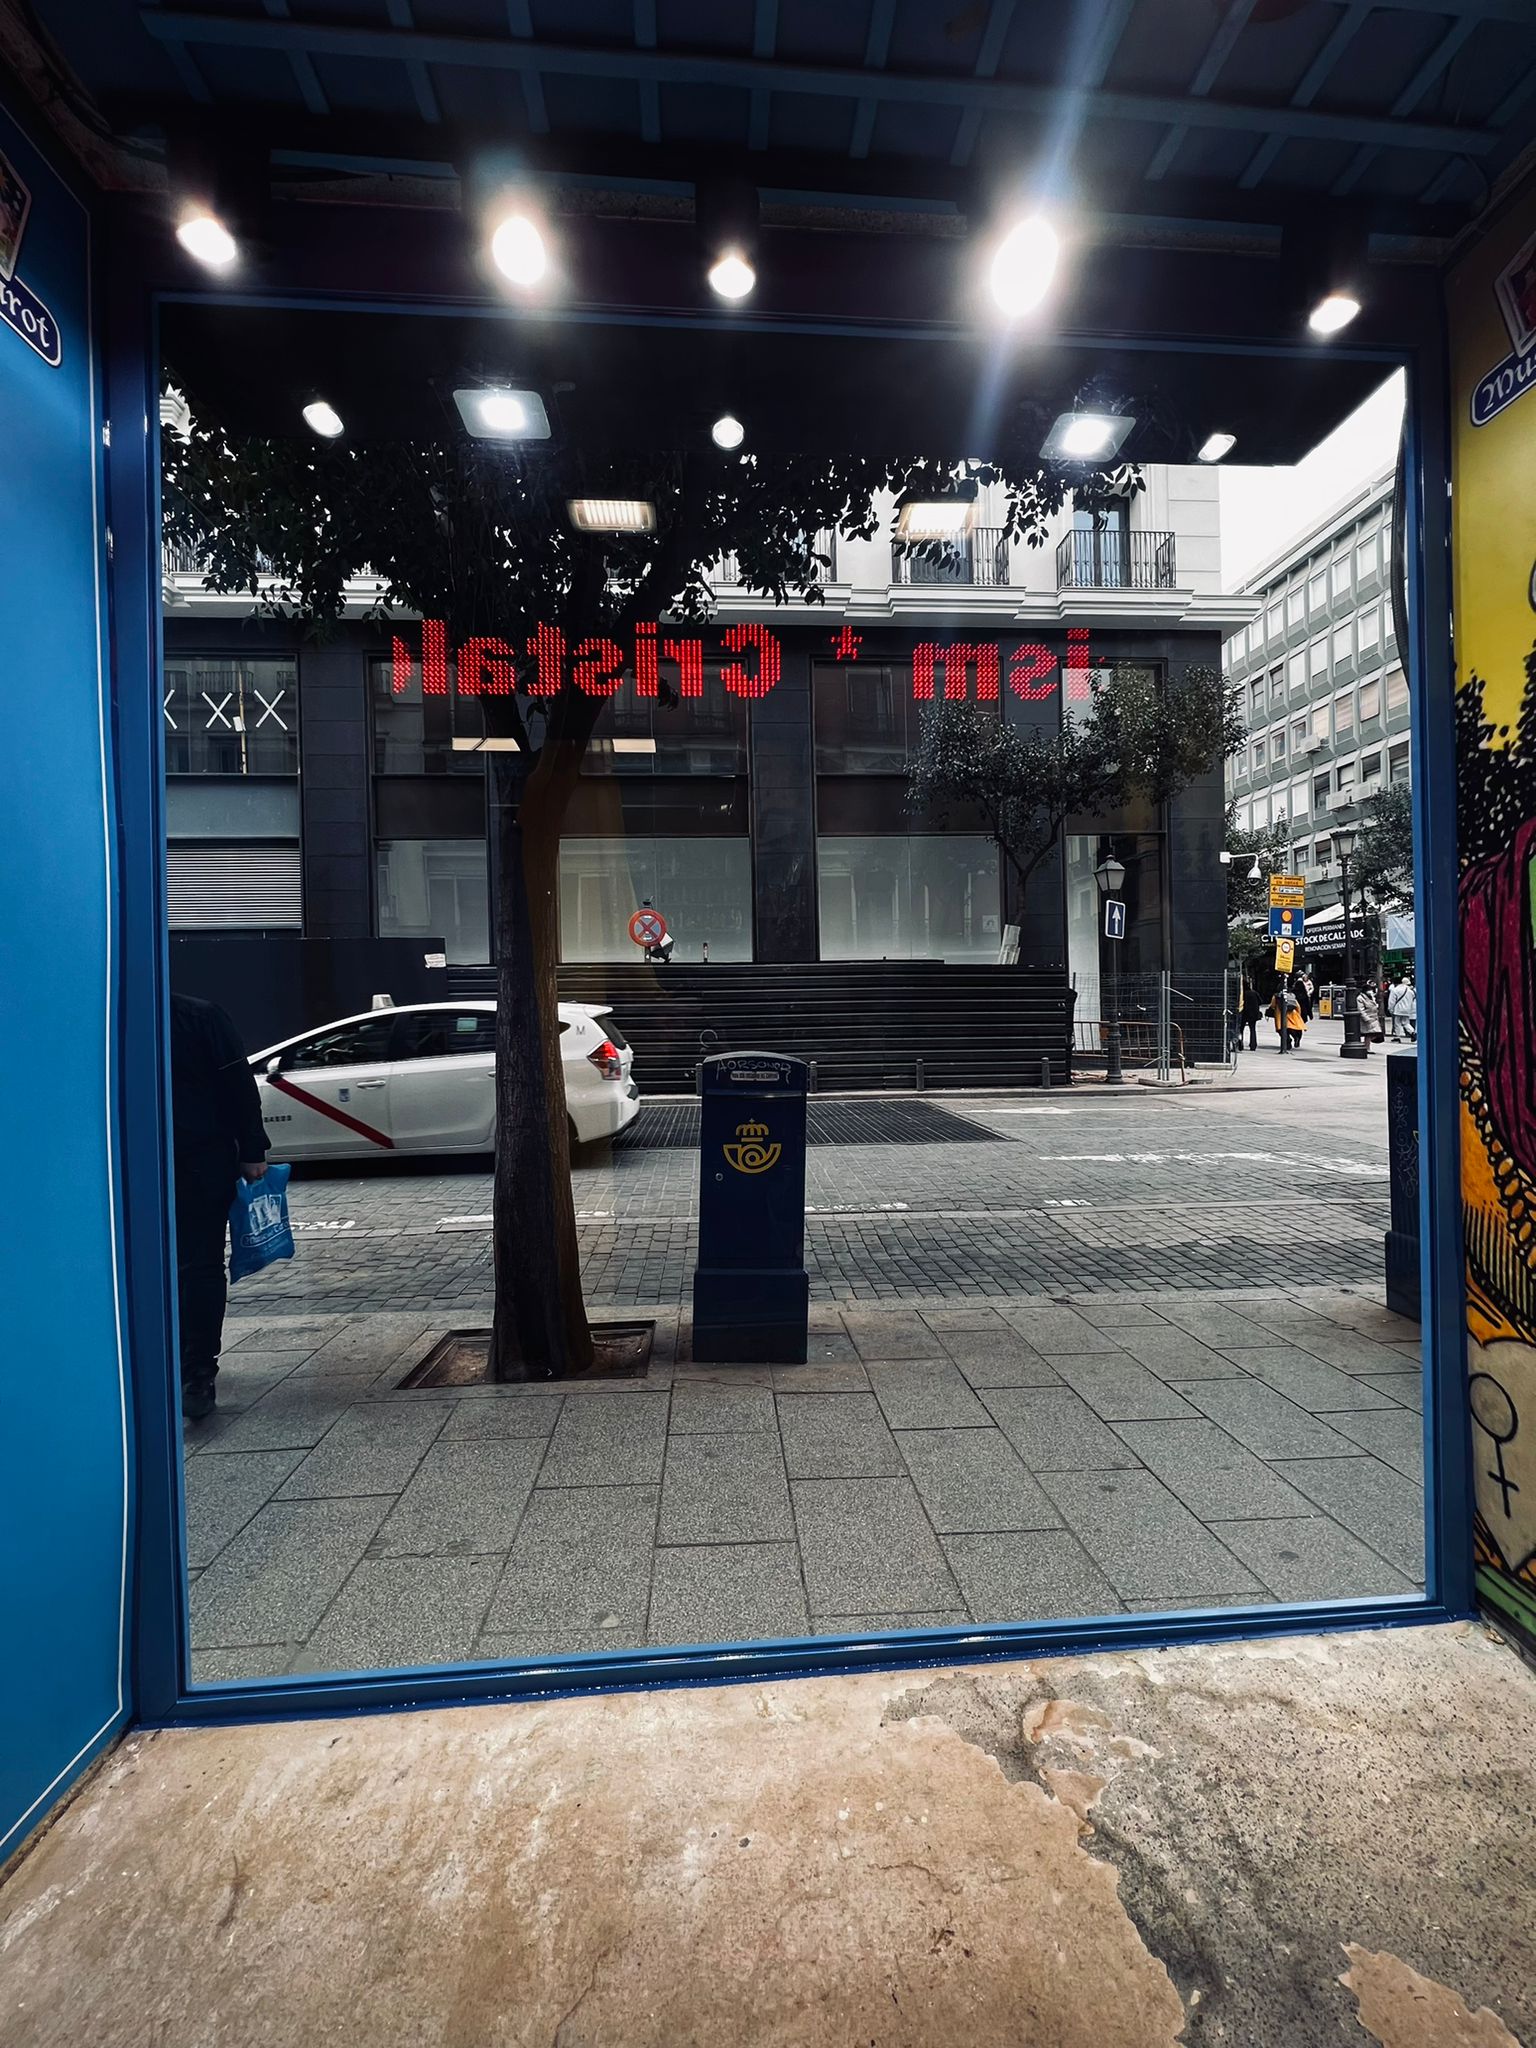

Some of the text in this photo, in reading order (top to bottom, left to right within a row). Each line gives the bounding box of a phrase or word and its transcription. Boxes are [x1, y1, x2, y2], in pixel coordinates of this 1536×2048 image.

[1481, 354, 1536, 413] Mu
[1295, 935, 1318, 945] STOCK
[1318, 933, 1328, 942] DE
